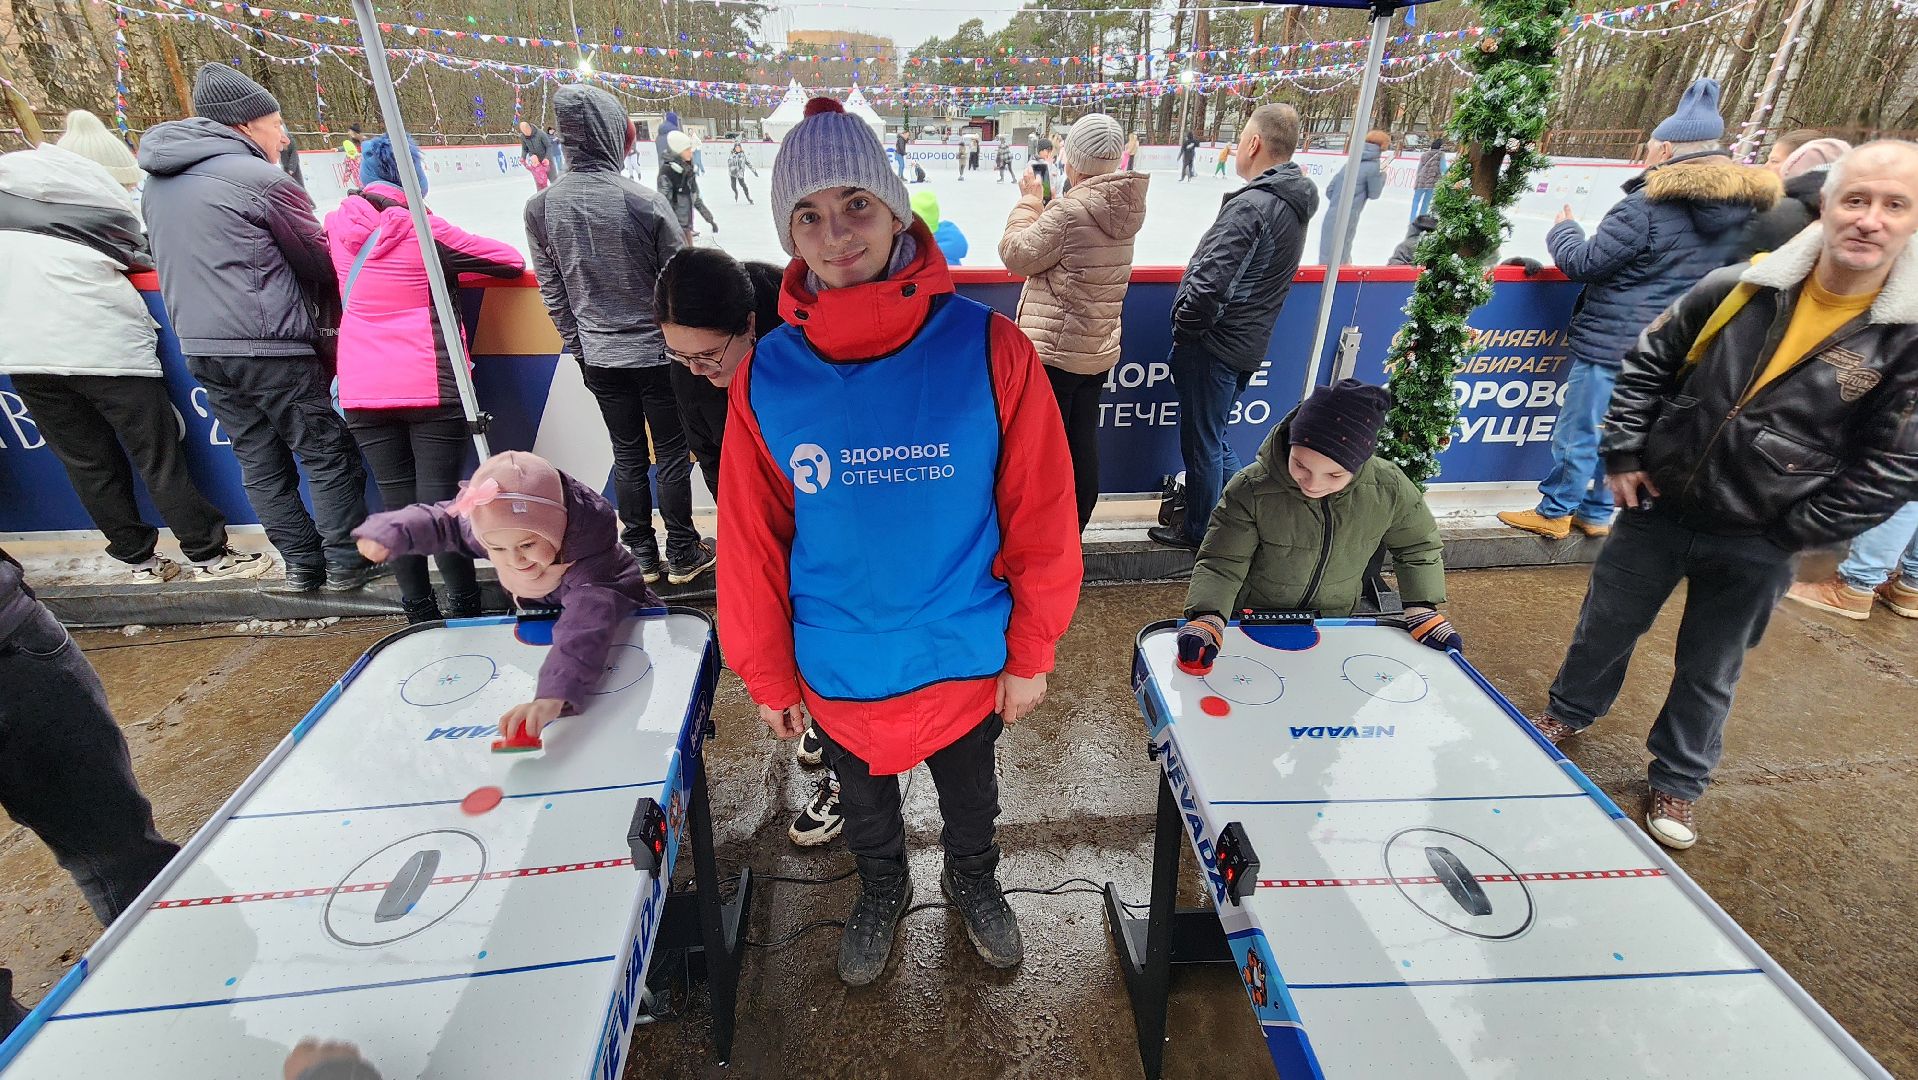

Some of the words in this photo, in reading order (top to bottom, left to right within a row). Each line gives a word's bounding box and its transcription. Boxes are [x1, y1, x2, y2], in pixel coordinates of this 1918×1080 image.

[906, 151, 959, 160] ЗДОРОВО
[1453, 356, 1567, 374] ЫБИРАЕТ
[840, 443, 950, 465] ЗДОРОВОЕ
[841, 464, 955, 485] ОТЕЧЕСТВО
[1290, 726, 1395, 740] NEVADA
[1158, 740, 1227, 904] NEVADA
